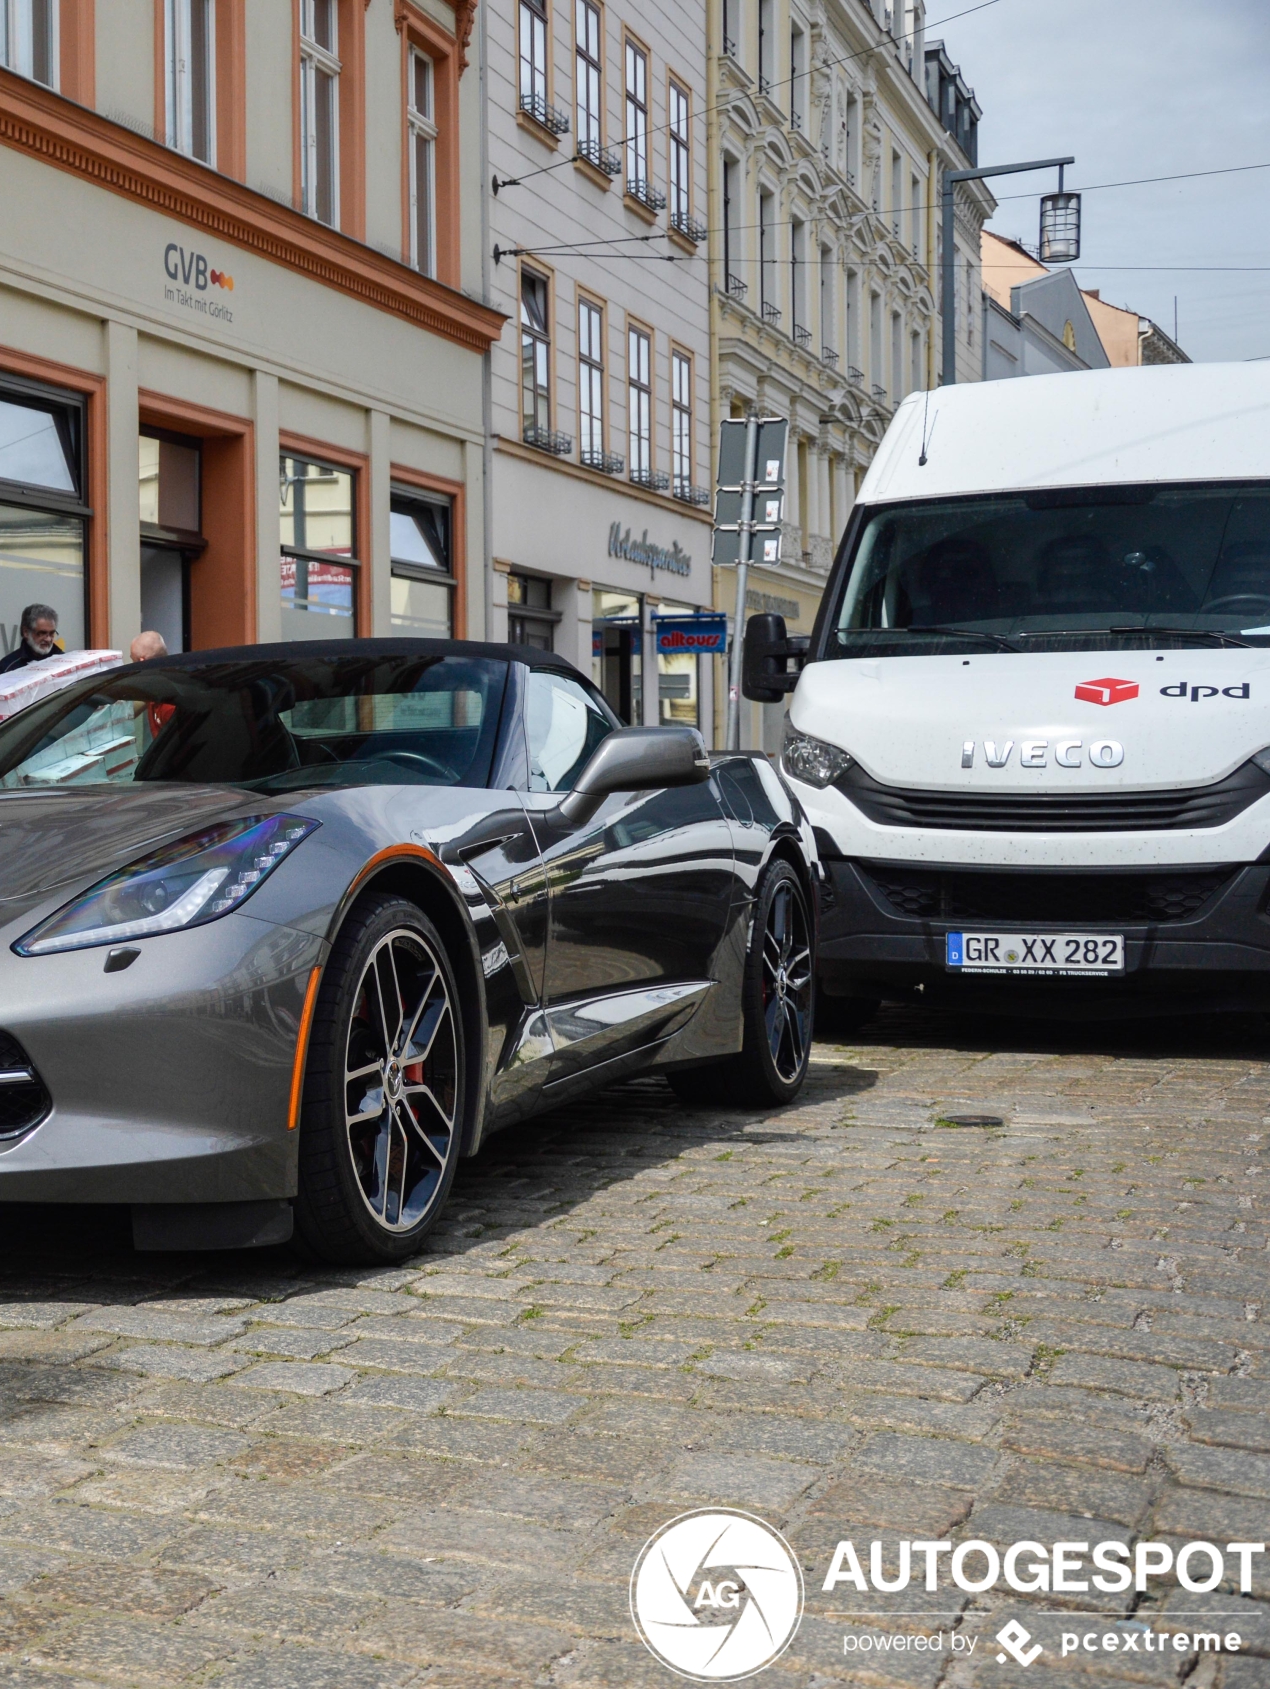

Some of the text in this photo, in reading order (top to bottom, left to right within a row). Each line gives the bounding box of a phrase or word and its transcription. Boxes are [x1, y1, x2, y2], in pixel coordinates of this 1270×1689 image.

[164, 243, 208, 291] GVB
[164, 284, 233, 323] Im Takt mit Görlitz
[660, 631, 720, 648] alltours
[1159, 682, 1251, 702] dpd
[961, 740, 1125, 769] IVECO
[951, 937, 1118, 965] D GR XX 282
